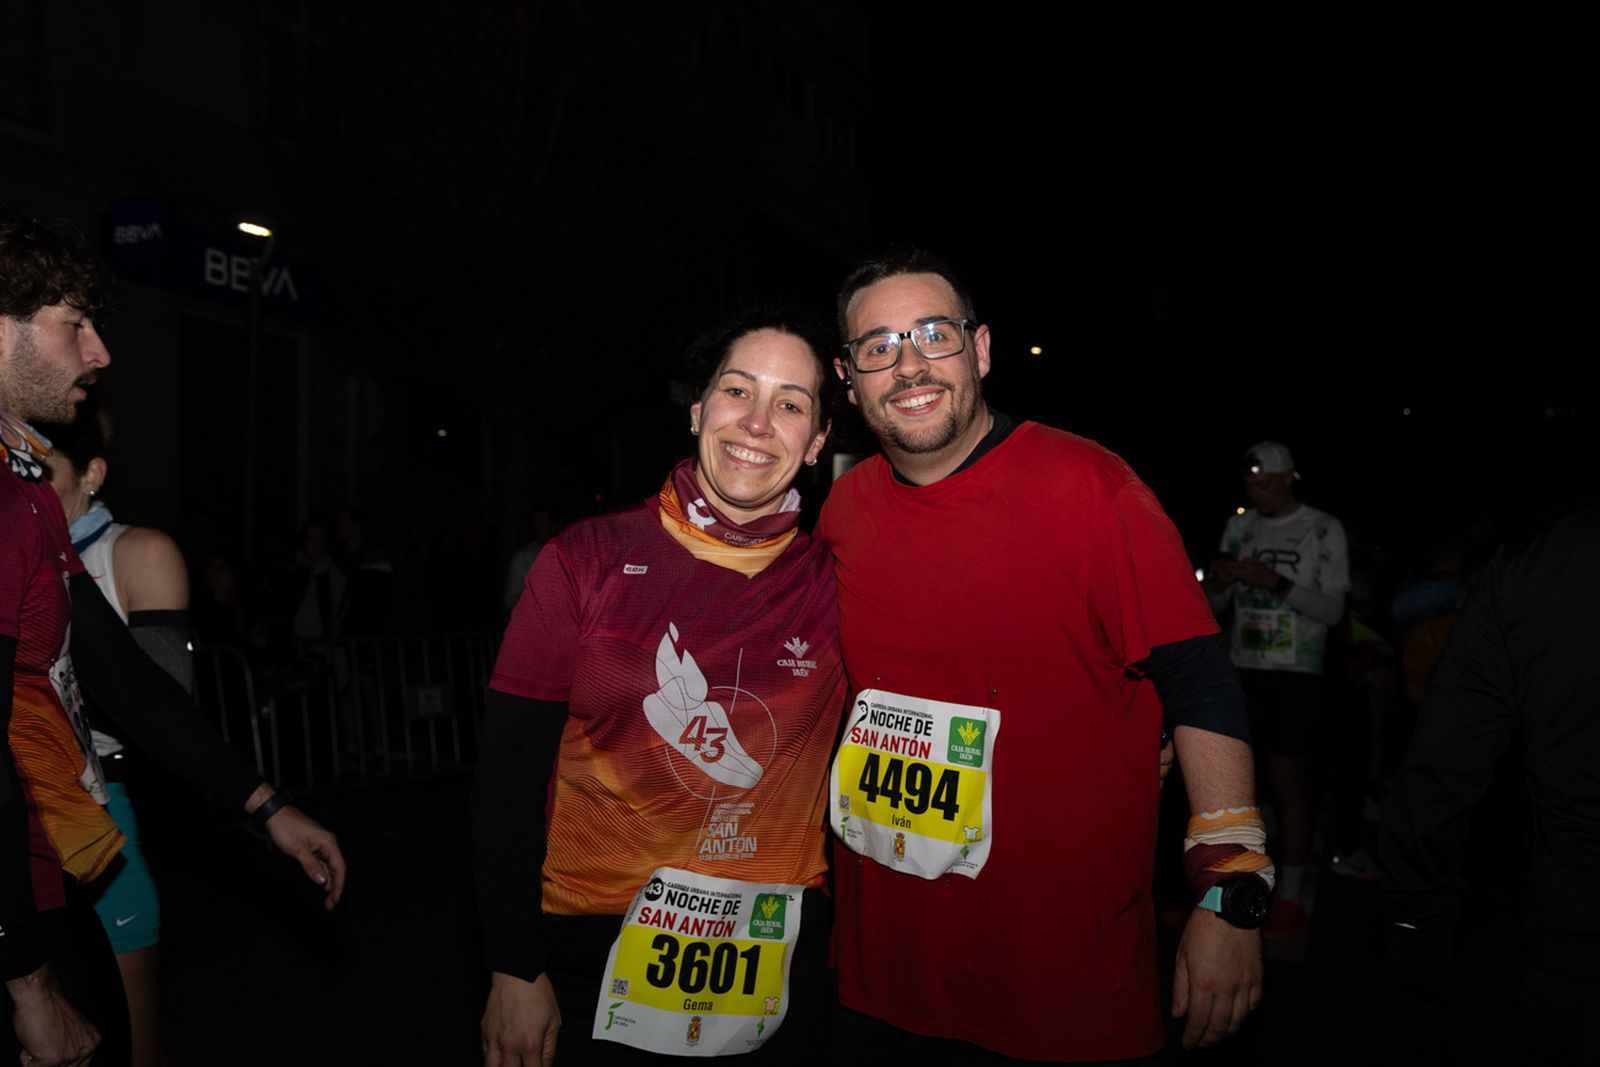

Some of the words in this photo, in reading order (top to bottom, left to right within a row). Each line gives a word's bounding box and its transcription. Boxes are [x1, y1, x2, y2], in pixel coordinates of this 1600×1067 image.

[113, 221, 163, 246] BBVA
[203, 246, 300, 303] BBVA
[869, 709, 912, 732] NOCHE
[913, 719, 934, 736] DE
[678, 714, 728, 763] 43
[851, 727, 879, 748] SAN
[880, 735, 932, 759] ANTÓN
[858, 752, 960, 821] 4494
[699, 832, 758, 854] ANTÓN
[706, 823, 739, 838] SAN
[664, 889, 721, 915] NOCHE
[722, 900, 741, 916] DE
[638, 906, 678, 931] SAN
[678, 915, 736, 938] ANTÓN
[646, 933, 761, 995] 3601
[683, 998, 713, 1011] Gema
